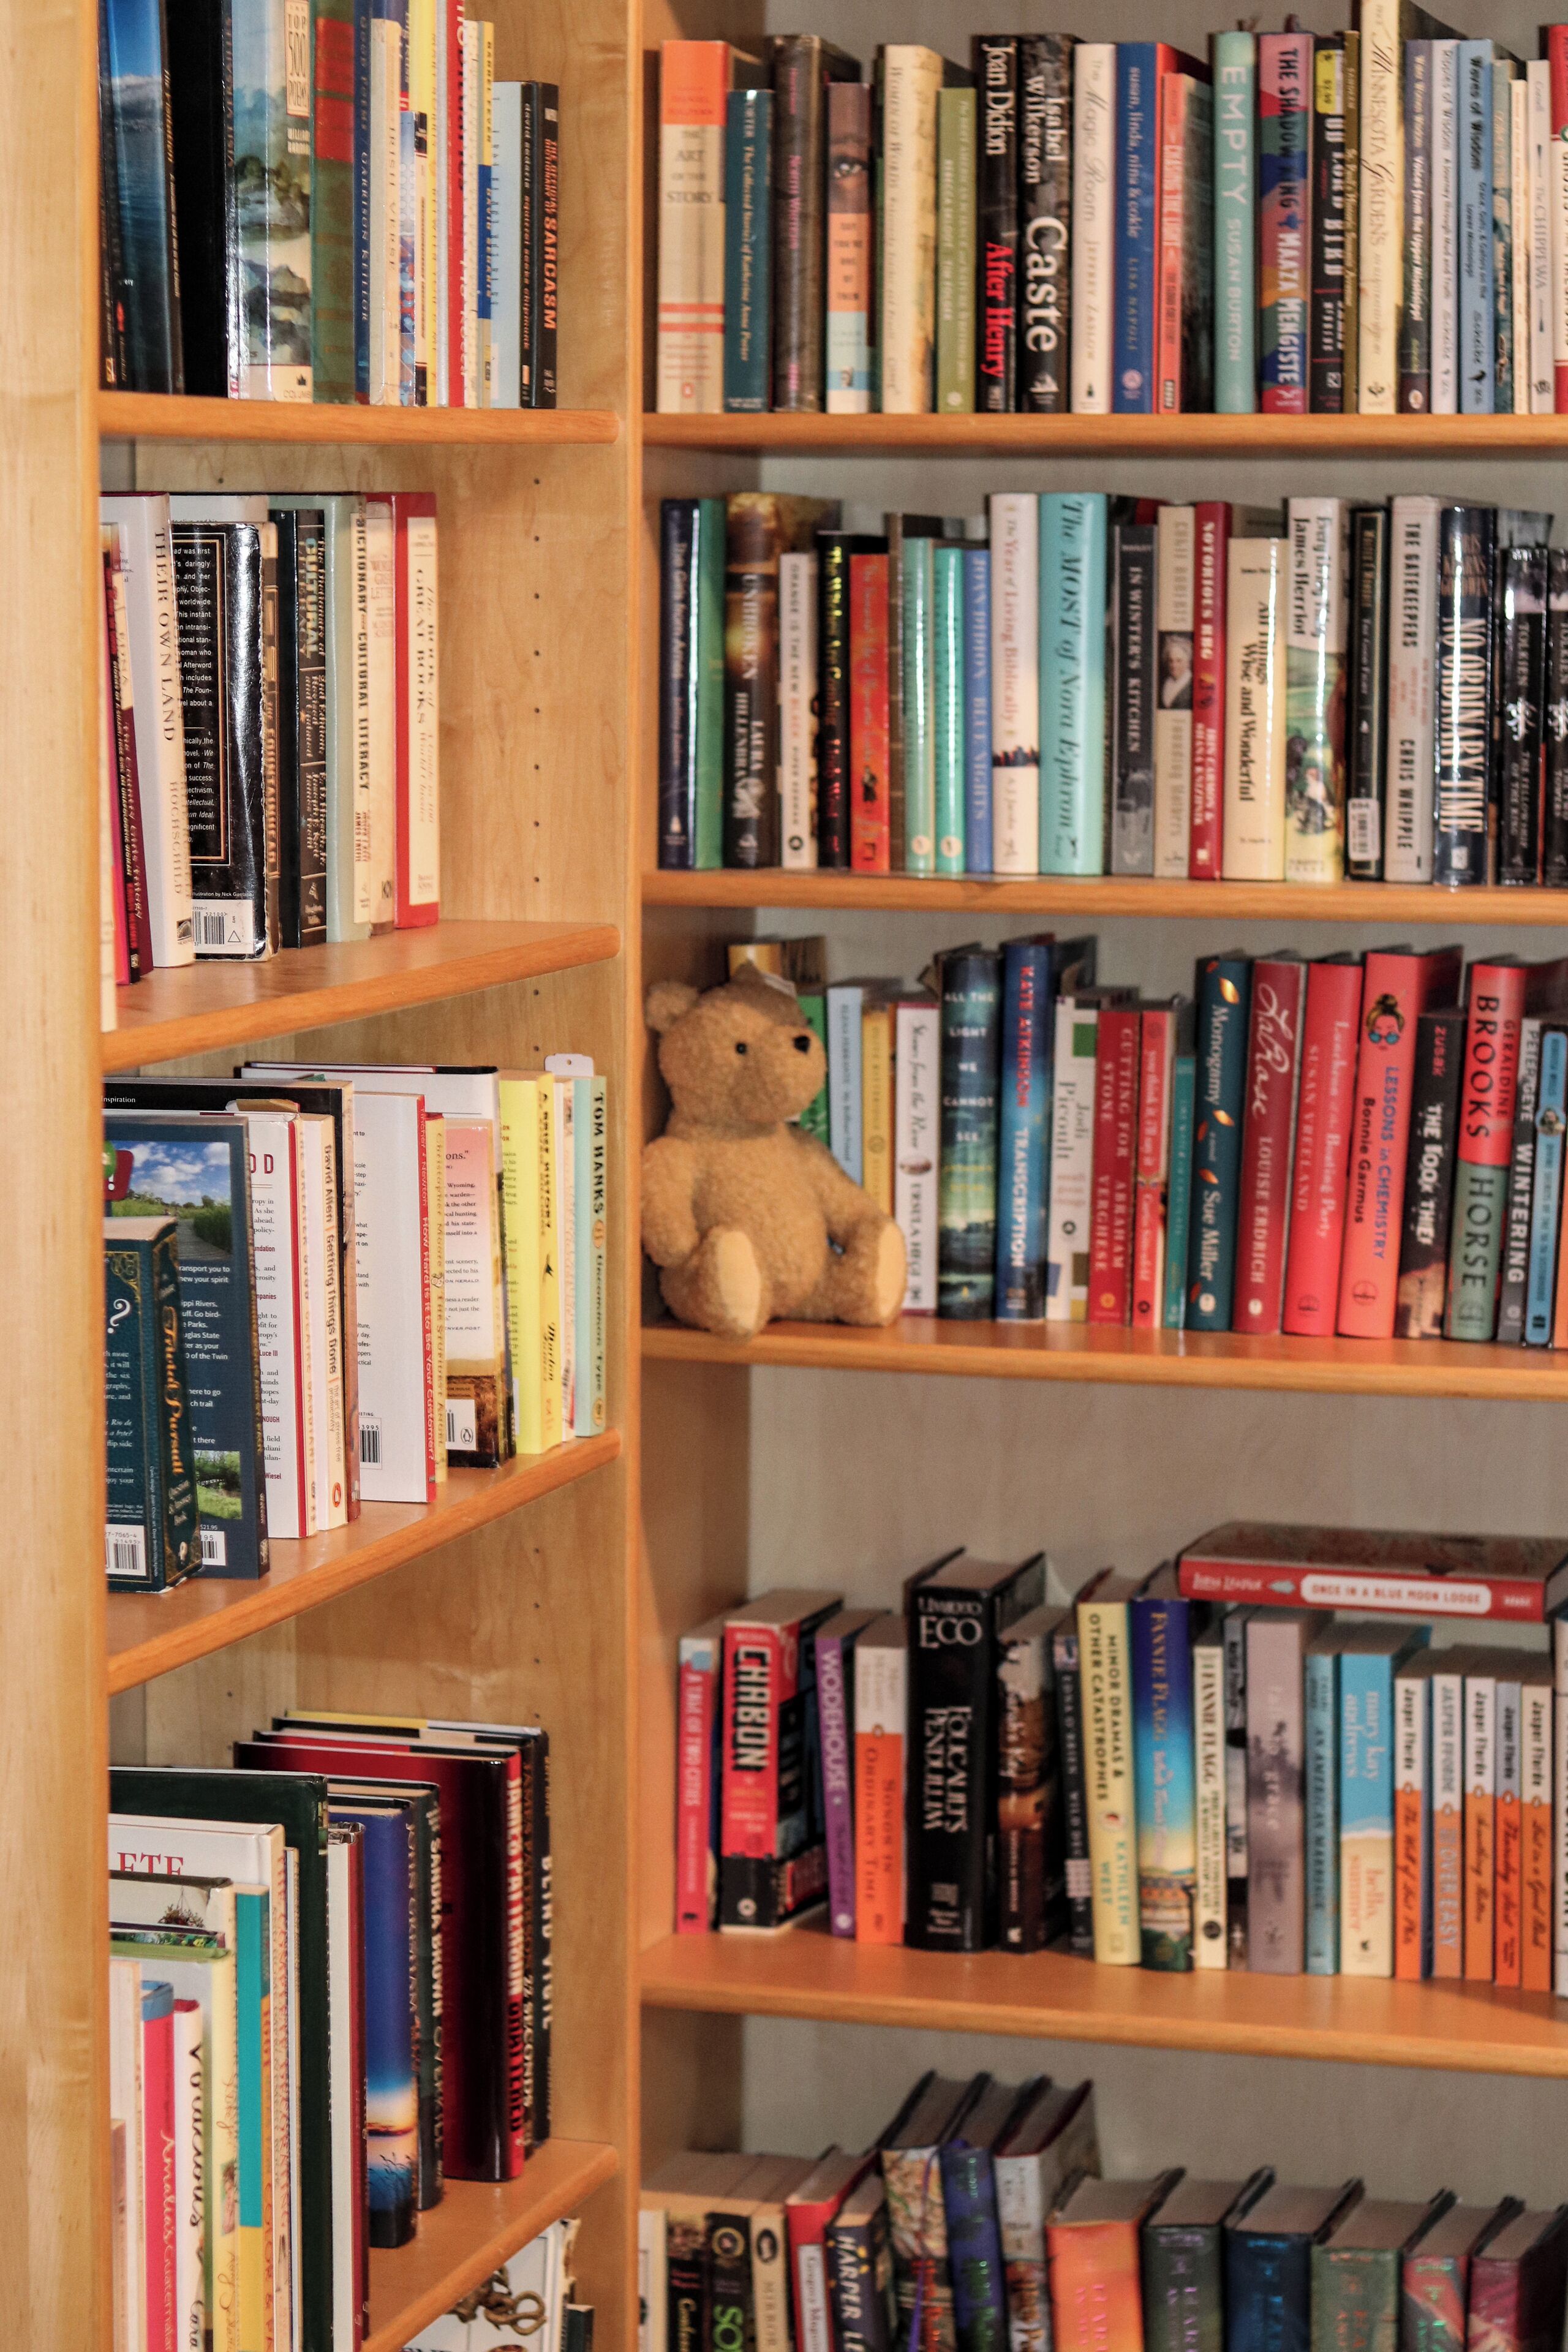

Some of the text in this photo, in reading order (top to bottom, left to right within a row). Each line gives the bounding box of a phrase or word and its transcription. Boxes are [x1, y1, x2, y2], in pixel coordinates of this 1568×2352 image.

[288, 14, 306, 29] TOP
[1469, 56, 1483, 171] Waves of Wisdom
[981, 43, 1016, 379] Joan Didion After Henry
[1025, 75, 1068, 352] Isabel Wilkerson Caste
[1221, 65, 1247, 361] EMPTY SUSAN BURTON
[1276, 49, 1302, 383] THE SHADOW KING MAAZA MENGISTE
[1534, 206, 1547, 290] CHIPPEWA
[1200, 521, 1215, 660] NOTORIOUS RBG
[1294, 518, 1310, 635] James Herriot
[1404, 522, 1421, 547] THE
[154, 528, 176, 742] THEIR OWN LAND
[357, 518, 369, 791] DICTIONARY CULTURAL LITERACY
[1001, 519, 1018, 722] The Year of Living Biblically
[1128, 567, 1142, 752] IN WINTER'S KITCHEN
[1403, 554, 1420, 648] GATEKEEPERS
[1442, 617, 1485, 647] NO
[1517, 622, 1530, 687] TOLKIEN
[1054, 500, 1082, 829] The MOST of Nora Ephron
[1238, 643, 1257, 801] Wise and Wonderful
[1441, 652, 1485, 771] ORDINARY
[265, 728, 277, 863] FOUNTAINHEAD
[750, 720, 764, 771] LAURA
[1399, 739, 1415, 781] CHRIS
[1441, 777, 1485, 833] TIME
[168, 780, 183, 894] HOCHSCHILD
[1397, 788, 1414, 850] WHIPPLE
[1101, 1061, 1114, 1123] STONE
[1116, 1028, 1133, 1158] CUTTING FOR
[1433, 1026, 1446, 1076] zusak
[1467, 995, 1499, 1139] BROOKS
[1497, 1020, 1515, 1117] GERALDINE
[1011, 965, 1033, 1268] KATE ATKINSON TRANSCRIPTION
[1056, 1081, 1077, 1161] Picoult
[1074, 1103, 1088, 1139] Jodi
[1199, 1005, 1228, 1281] Monogamy Sue Miller
[1251, 984, 1292, 1283] LaRose LOUISE ERDRICH
[1296, 1046, 1319, 1212] SUSAN VREELAND
[1354, 1096, 1375, 1223] Bonnie Garmus
[1373, 1066, 1399, 1259] LESSONS in CHEMISTRY
[1423, 1105, 1442, 1137] THE
[323, 1145, 337, 1374] David Allen Getting Things Done
[593, 1092, 605, 1392] TOM HANKS Uncommon Type
[1095, 1174, 1110, 1273] VERGHESE
[1112, 1180, 1127, 1268] ABRAHAM
[1462, 1177, 1494, 1287] HORSE
[162, 1306, 185, 1474] Trivial Pursuit
[919, 1616, 982, 1648] ECO
[1151, 1612, 1172, 1742] FANNIE FLAGG
[734, 1645, 770, 1771] CHABON
[821, 1648, 845, 1792] WODEHOUSE
[1090, 1613, 1109, 1801] OTHER CATASTROPHES
[1107, 1635, 1125, 1779] MINOR DRAMAS &
[1200, 1673, 1218, 1785] FANNIE FLAGG
[1343, 1694, 1365, 1779] andrews
[1363, 1691, 1385, 1781] mary kay
[864, 1747, 880, 1904] ORDINARY TIME
[923, 1707, 947, 1830] PENDULUM
[429, 1840, 443, 2016] SANDRA BROWN
[1099, 1862, 1114, 1905] WEST
[1115, 1841, 1131, 1926] KATHLEEN
[1438, 1847, 1458, 1948] OVER EASY
[160, 2128, 175, 2244] Amalia's
[835, 2235, 861, 2320] HARPER
